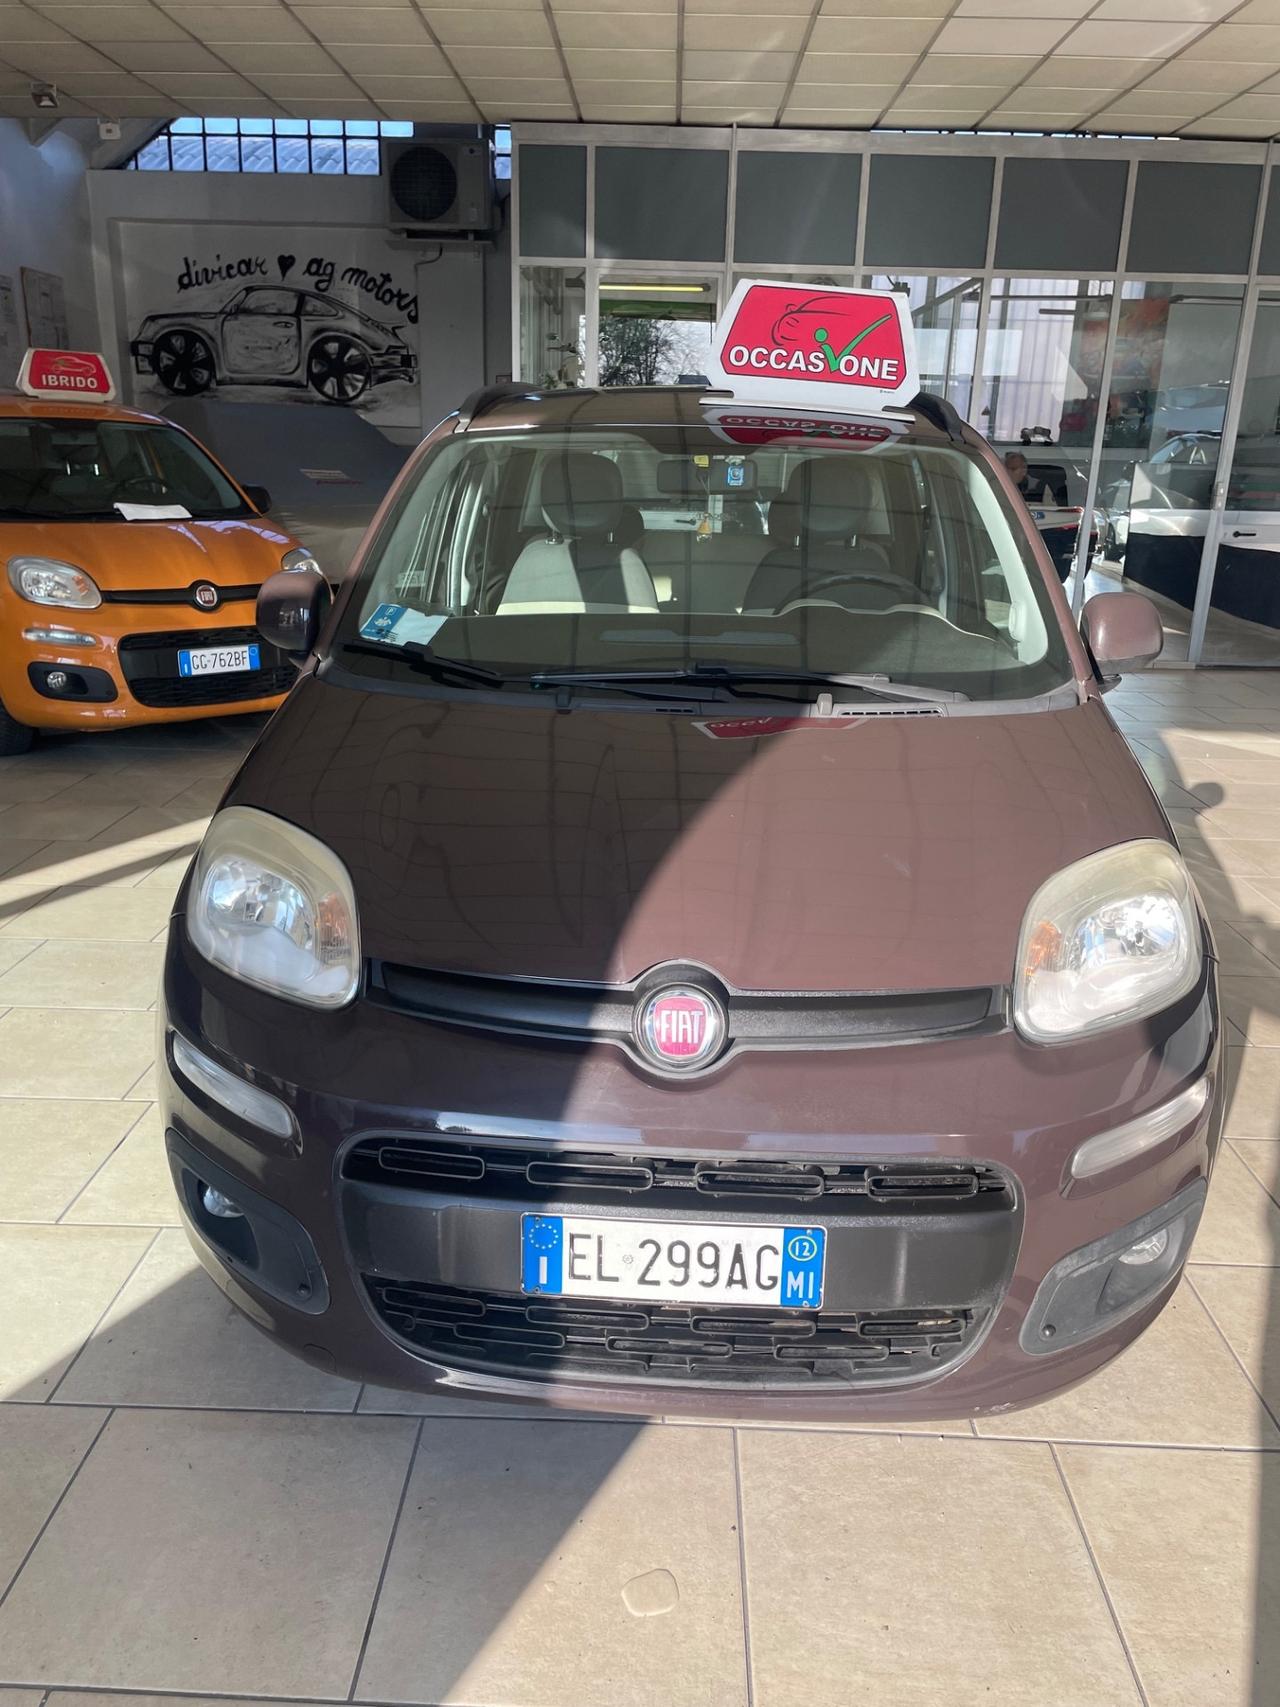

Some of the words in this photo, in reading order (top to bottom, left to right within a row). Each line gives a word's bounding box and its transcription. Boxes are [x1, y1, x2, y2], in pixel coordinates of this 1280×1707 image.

[177, 254, 268, 293] divicar
[303, 256, 336, 292] ag
[341, 265, 419, 324] motors
[41, 374, 98, 388] IBRIDO
[660, 1009, 704, 1044] FIAT
[568, 1231, 619, 1283] EL
[636, 1238, 780, 1291] 299AG
[794, 1240, 812, 1258] 12
[786, 1270, 814, 1299] MI
